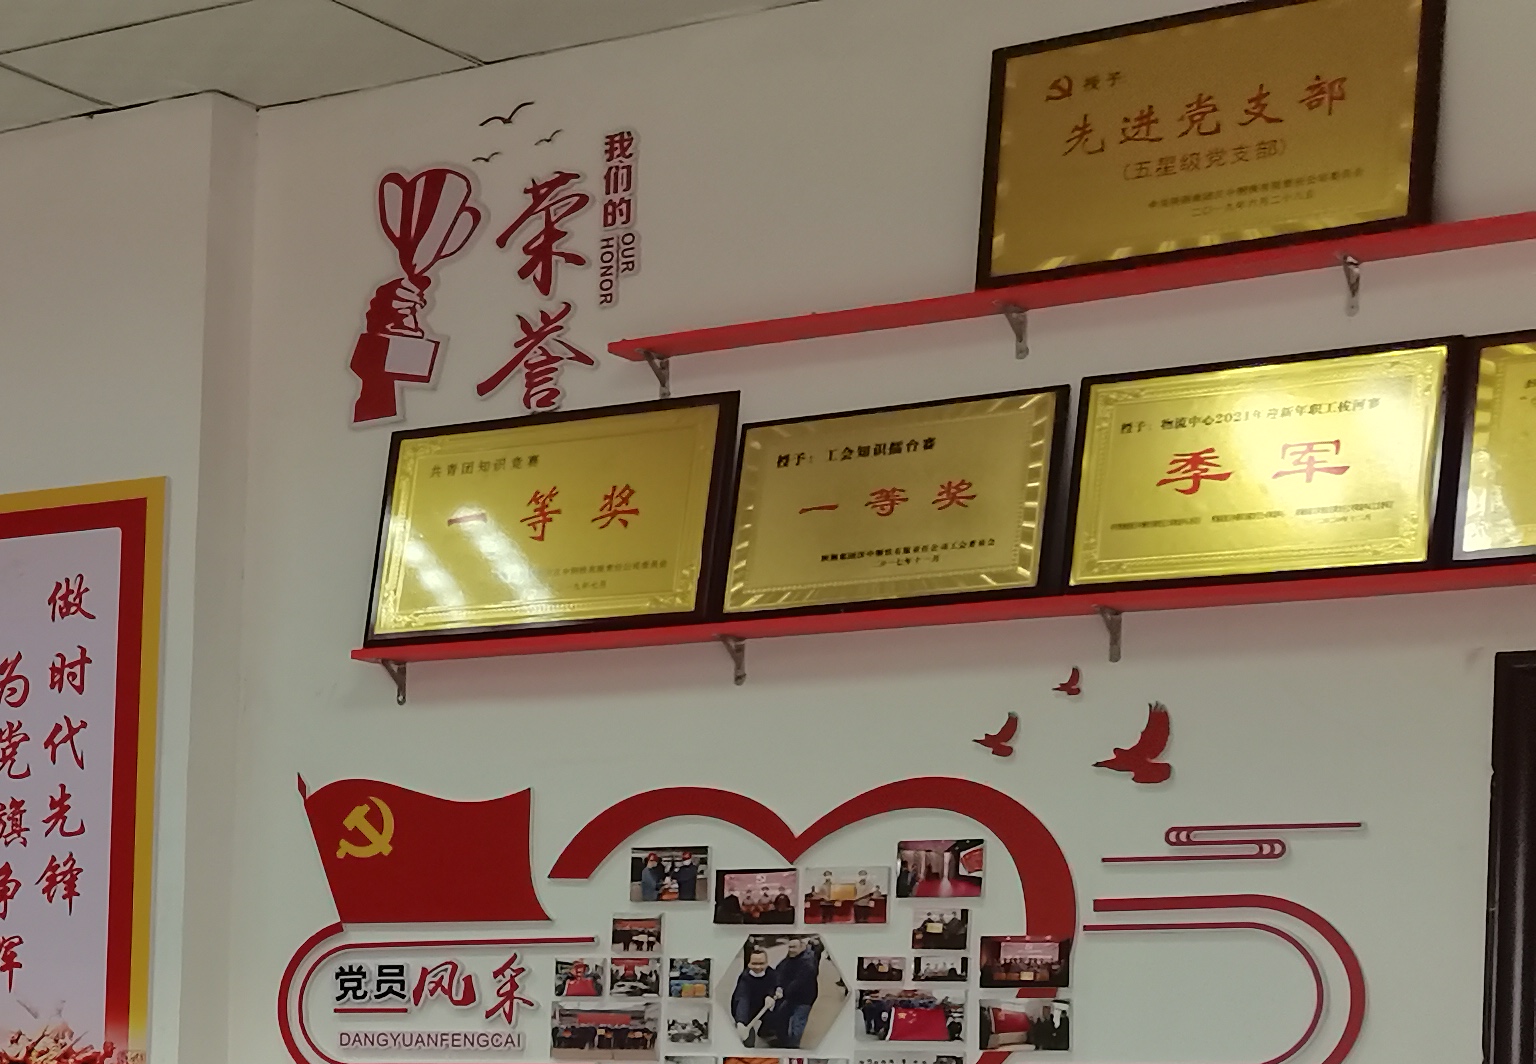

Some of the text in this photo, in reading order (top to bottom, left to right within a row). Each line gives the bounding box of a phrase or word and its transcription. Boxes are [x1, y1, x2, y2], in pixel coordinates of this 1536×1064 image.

[1063, 75, 1347, 156] 先进党支部
[602, 131, 634, 228] 我们的
[599, 237, 615, 305] HONOR
[620, 232, 636, 273] OUR
[477, 171, 594, 409] 荣誉
[429, 455, 540, 479] 共青团知识竞赛
[798, 478, 977, 517] 一等奖
[1157, 438, 1350, 495] 季军
[447, 484, 640, 541] 一等奖
[36, 573, 96, 916] 做时代先锋
[334, 952, 535, 1025] 党员风采
[339, 1032, 522, 1048] DANGYUANFENGCAI
